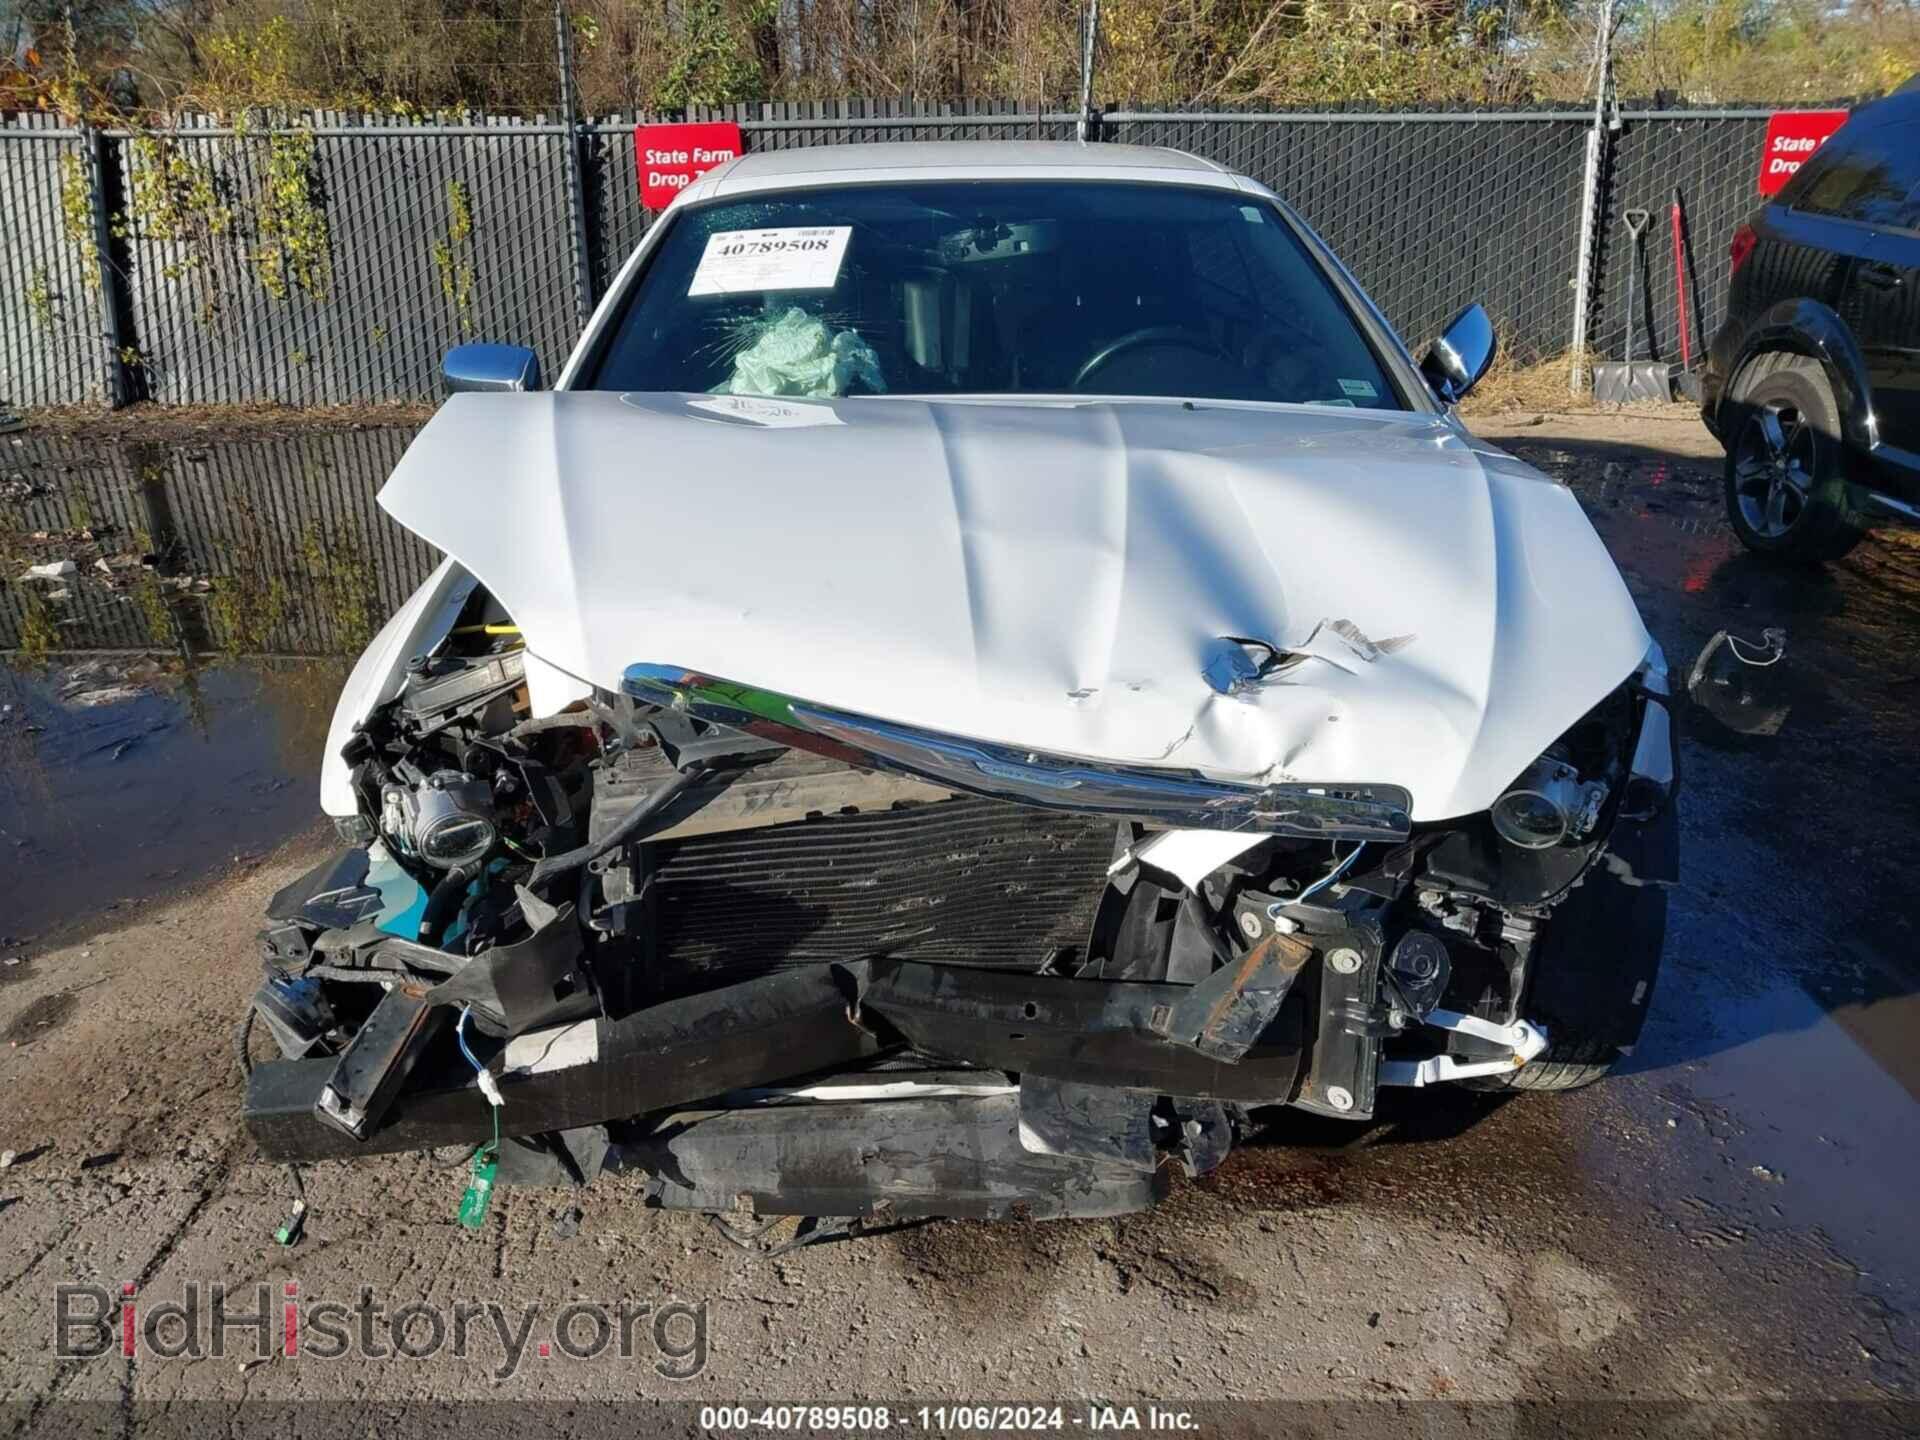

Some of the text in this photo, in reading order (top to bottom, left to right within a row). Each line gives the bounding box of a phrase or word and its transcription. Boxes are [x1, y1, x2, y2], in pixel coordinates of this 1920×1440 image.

[1772, 136, 1816, 152] State
[645, 148, 734, 164] State Farm
[1769, 158, 1801, 174] Dro
[648, 172, 689, 189] Drop
[717, 239, 829, 256] 40789508
